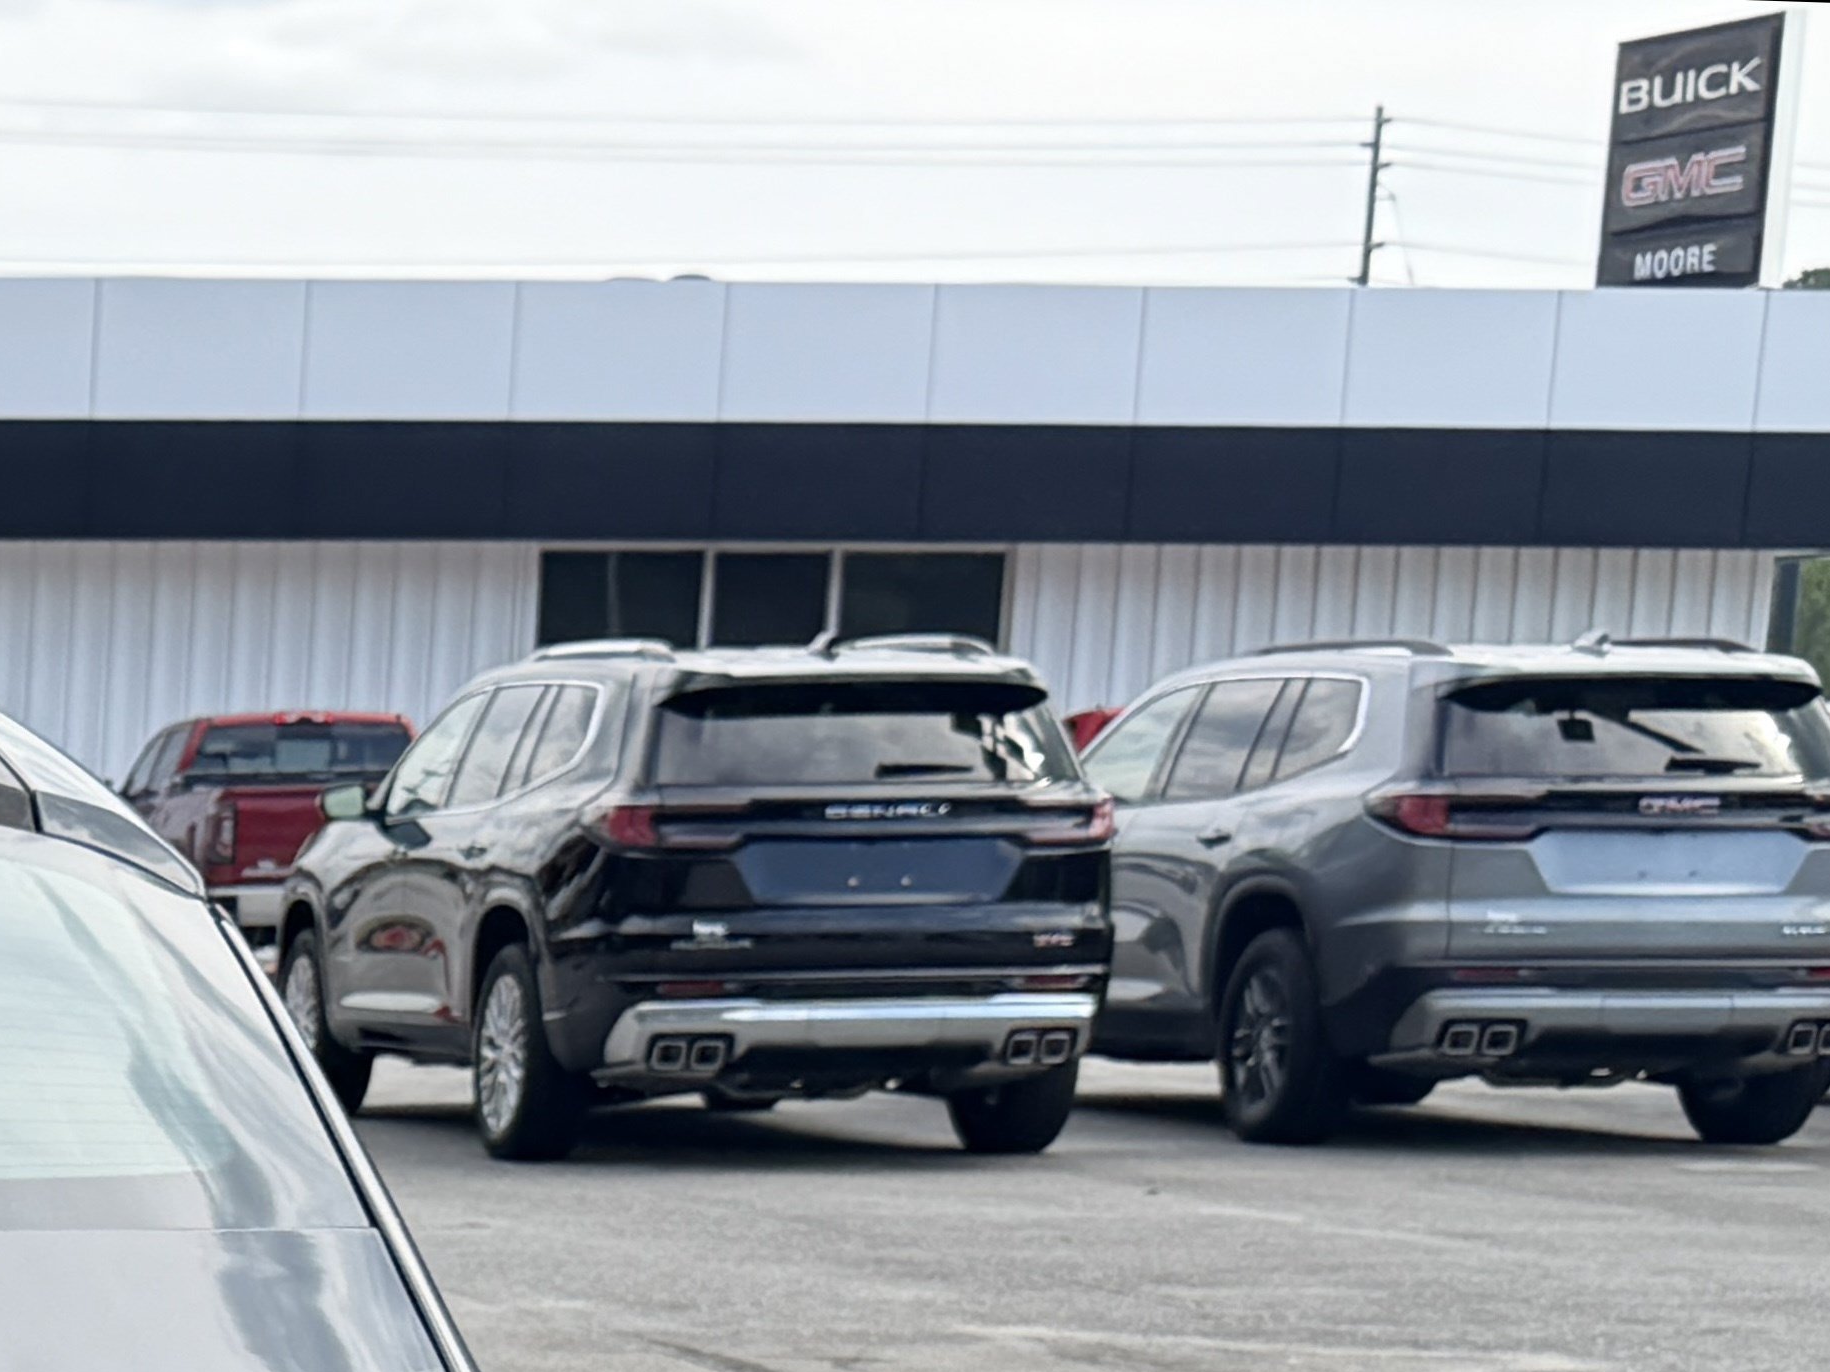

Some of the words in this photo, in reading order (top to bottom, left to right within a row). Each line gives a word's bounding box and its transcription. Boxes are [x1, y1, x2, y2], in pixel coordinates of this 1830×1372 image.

[1618, 56, 1762, 115] BUICK
[1621, 145, 1747, 208] GMC
[1633, 243, 1717, 281] MOORE
